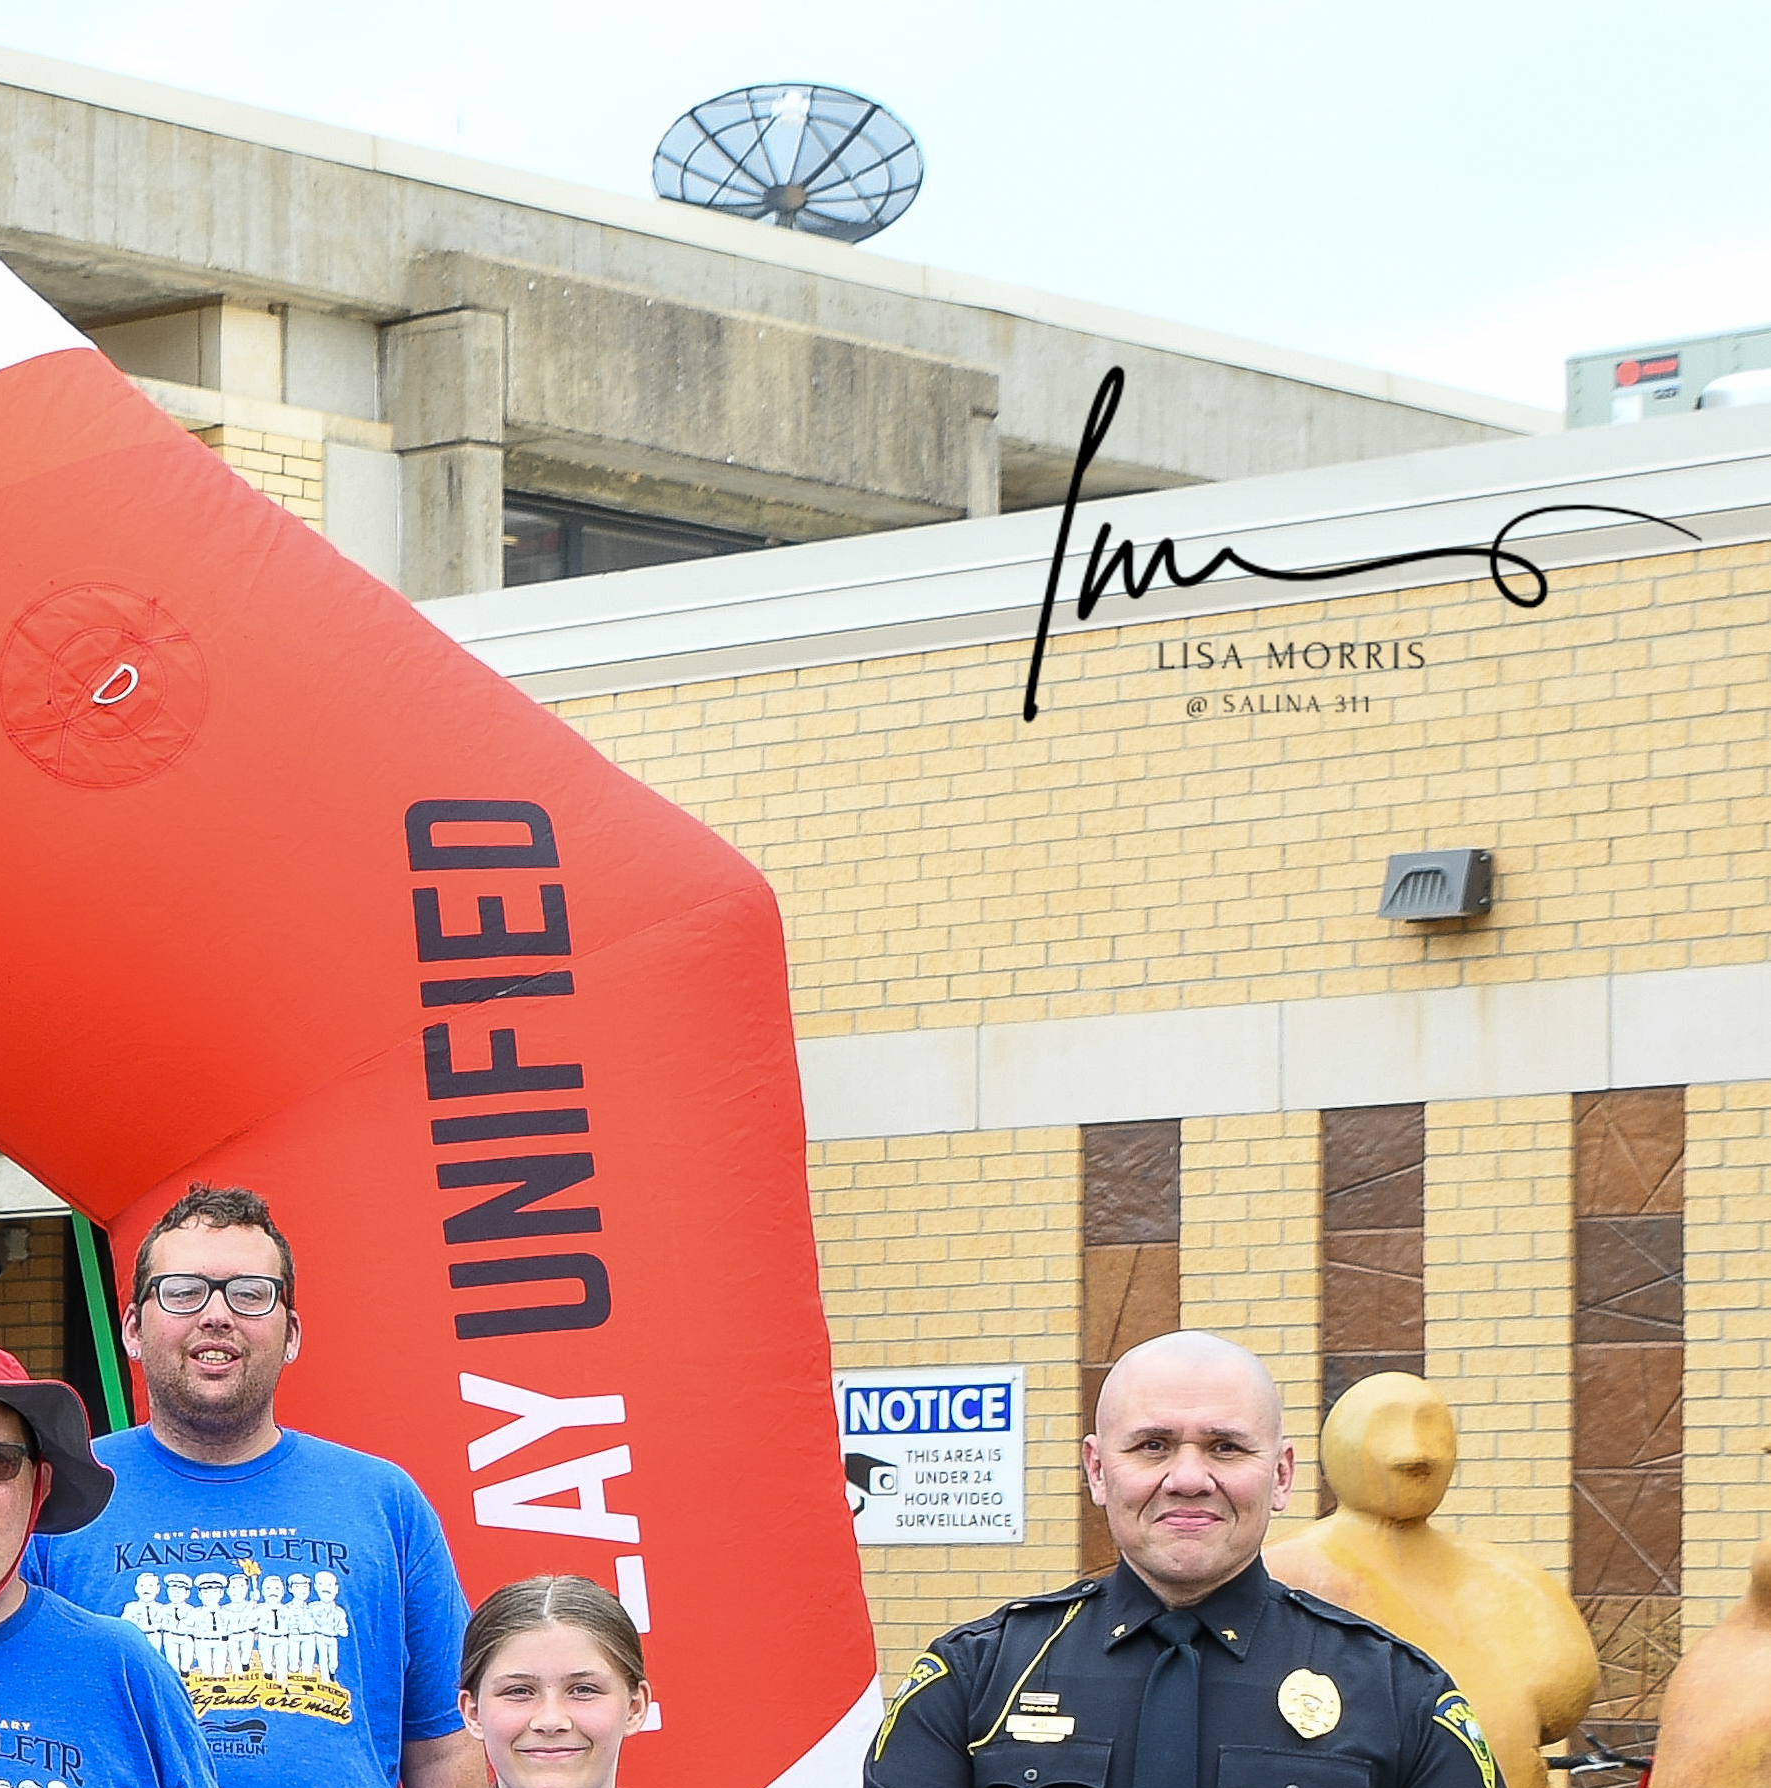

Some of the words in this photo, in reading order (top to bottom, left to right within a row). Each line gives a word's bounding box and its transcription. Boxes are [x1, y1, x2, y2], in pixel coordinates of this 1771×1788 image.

[403, 799, 612, 1341] UNIFIED
[850, 1388, 1006, 1431] NOTICE
[906, 1449, 939, 1463] THIS
[943, 1449, 984, 1462] AREA
[988, 1449, 1001, 1462] IS
[915, 1471, 969, 1485] UNDER
[974, 1470, 992, 1483] 24
[904, 1493, 949, 1506] HOUR
[953, 1492, 1003, 1505] VIDEO
[896, 1513, 1012, 1527] SURVEILLANCE
[115, 1539, 254, 1574] KANSAS
[263, 1538, 350, 1575] LETR
[265, 1696, 302, 1709] are
[304, 1696, 350, 1721] made
[236, 1742, 265, 1756] RUN
